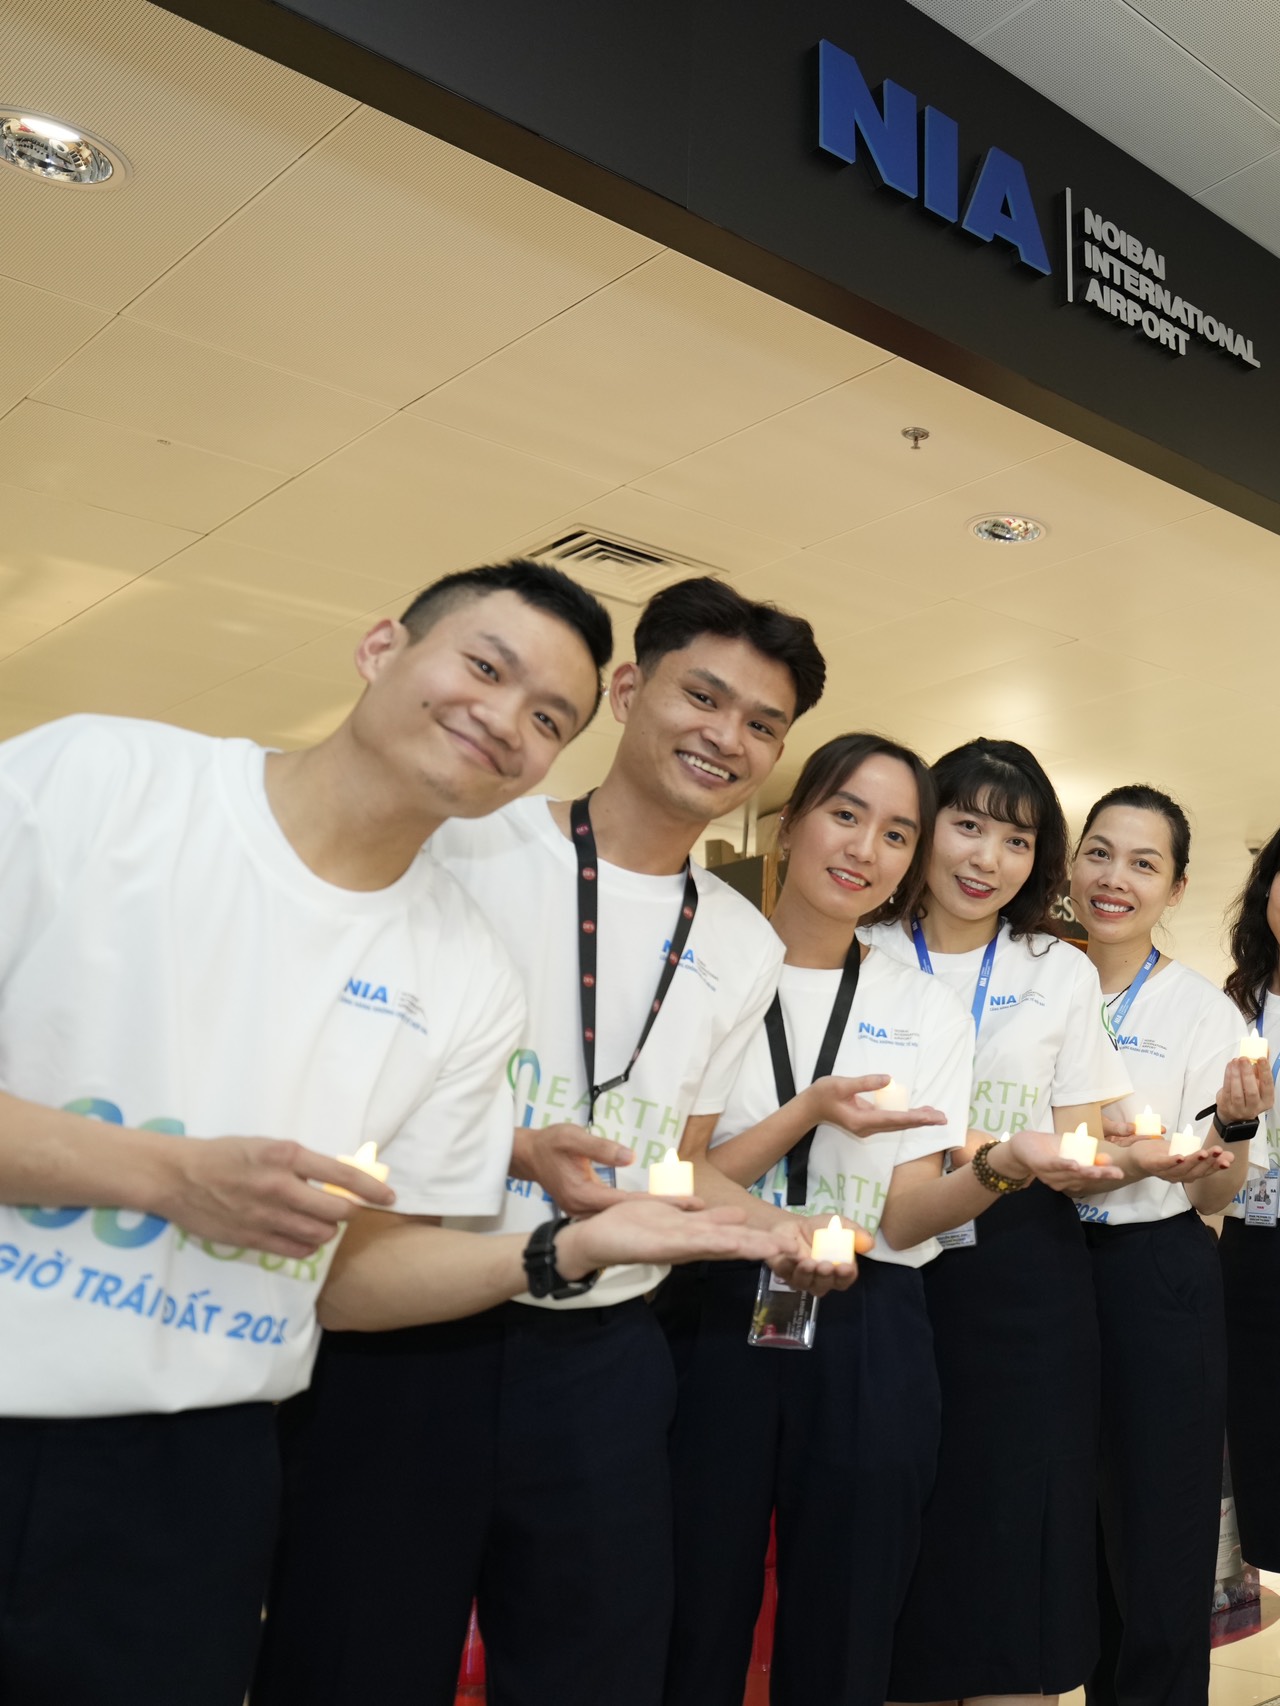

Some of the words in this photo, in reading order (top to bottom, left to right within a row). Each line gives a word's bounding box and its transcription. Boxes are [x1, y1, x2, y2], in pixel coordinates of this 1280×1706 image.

[818, 38, 1052, 276] NIA
[1084, 207, 1166, 281] NOIBAI
[1084, 241, 1261, 369] INTERNATIONAL
[1085, 277, 1190, 356] AIRPORT
[343, 977, 388, 1004] NIA
[990, 995, 1017, 1006] NIA
[859, 1022, 888, 1038] NIA
[1117, 1034, 1138, 1047] NIA
[72, 1266, 164, 1319] TRÁI
